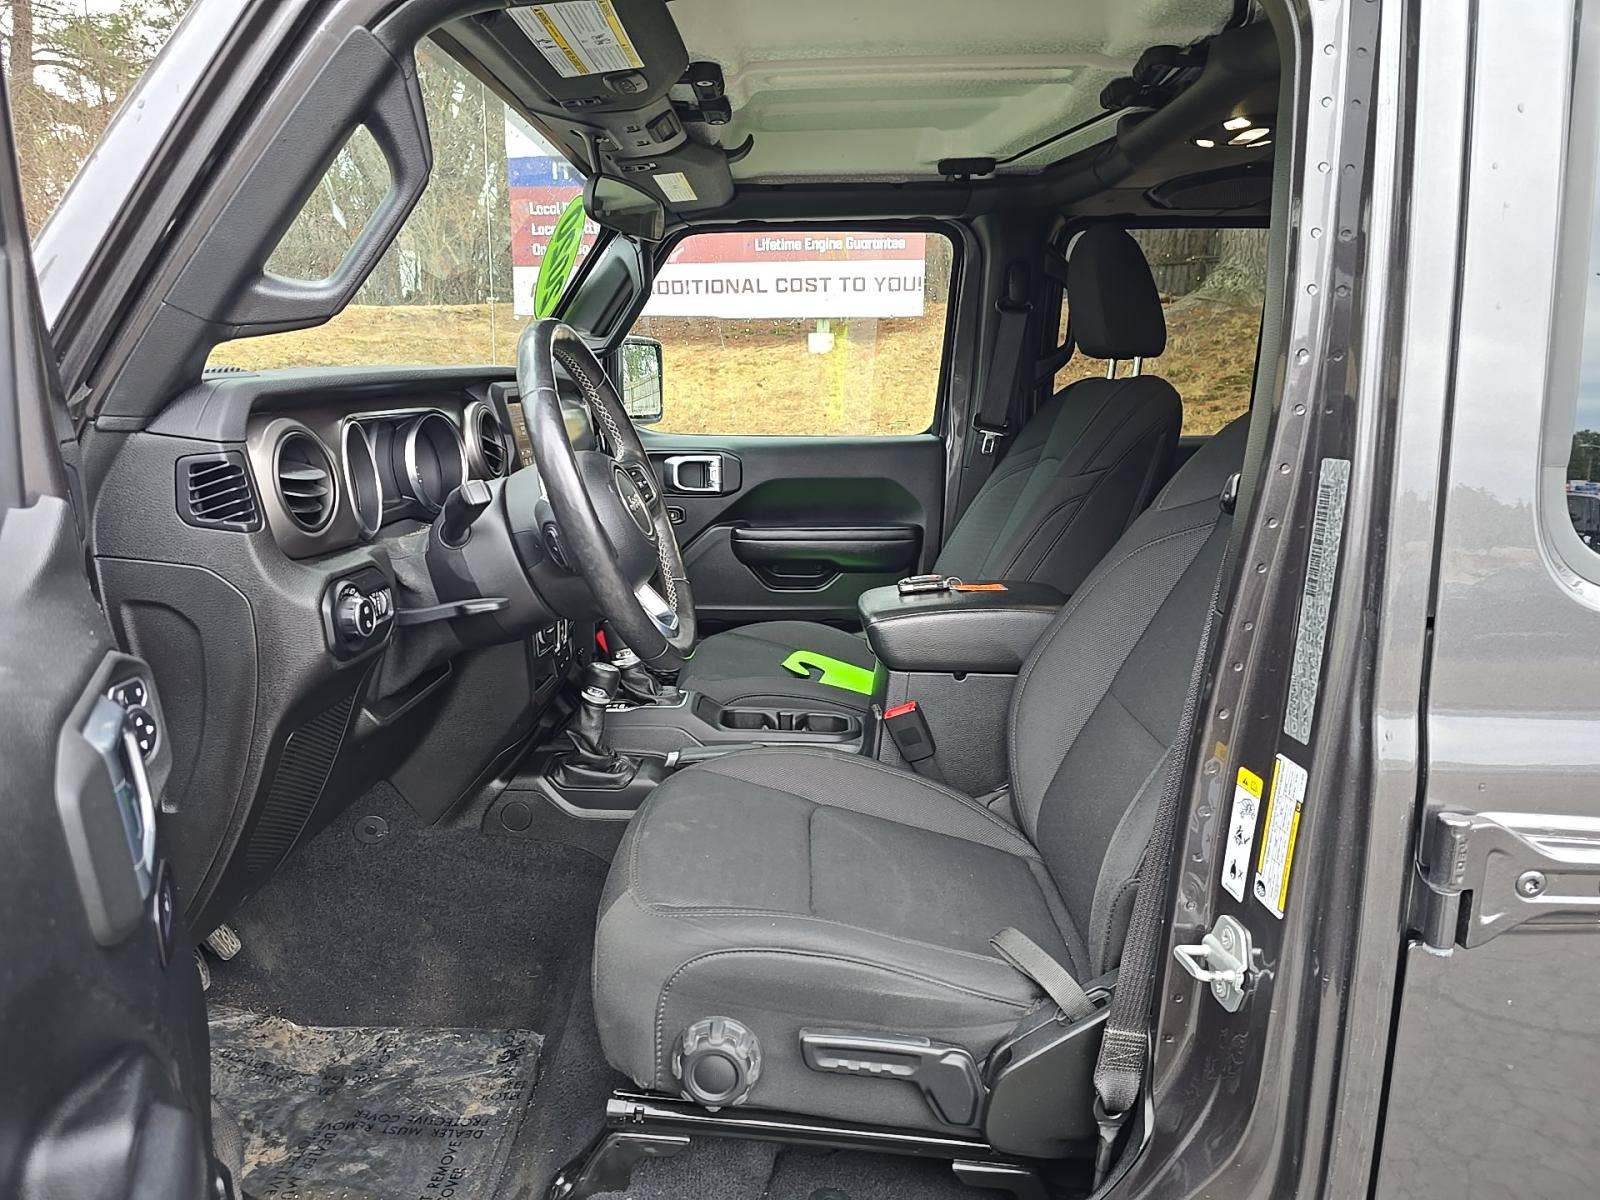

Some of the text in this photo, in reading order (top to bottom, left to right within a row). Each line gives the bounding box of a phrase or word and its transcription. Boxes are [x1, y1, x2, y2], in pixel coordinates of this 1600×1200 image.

[529, 202, 560, 216] Local
[754, 236, 906, 253] Lifetime Engine Guarantee
[651, 276, 922, 296] DDITIONAL COST TO YOU!
[354, 1109, 400, 1122] COVER
[382, 1126, 423, 1136] MUST
[431, 1127, 485, 1139] DEALER
[426, 1140, 463, 1189] REMOVE
[436, 1167, 467, 1200] OVER
